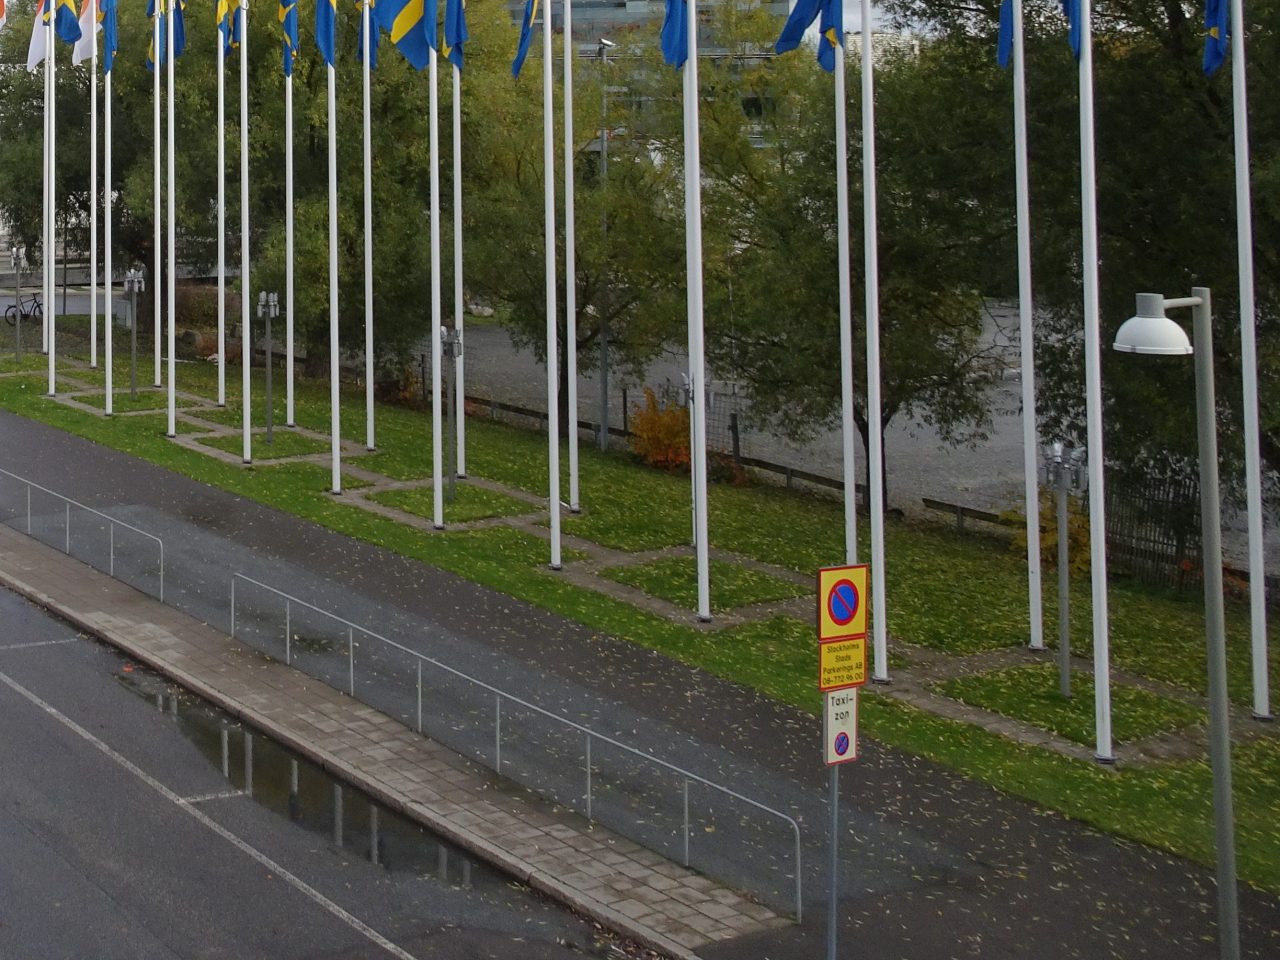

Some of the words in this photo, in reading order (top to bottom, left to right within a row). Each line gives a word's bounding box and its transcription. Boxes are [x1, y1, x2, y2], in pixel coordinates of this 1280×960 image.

[827, 643, 859, 653] Stockholms
[823, 665, 853, 674] Parkerings
[831, 694, 853, 706] Taxi-
[835, 711, 849, 720] zon
